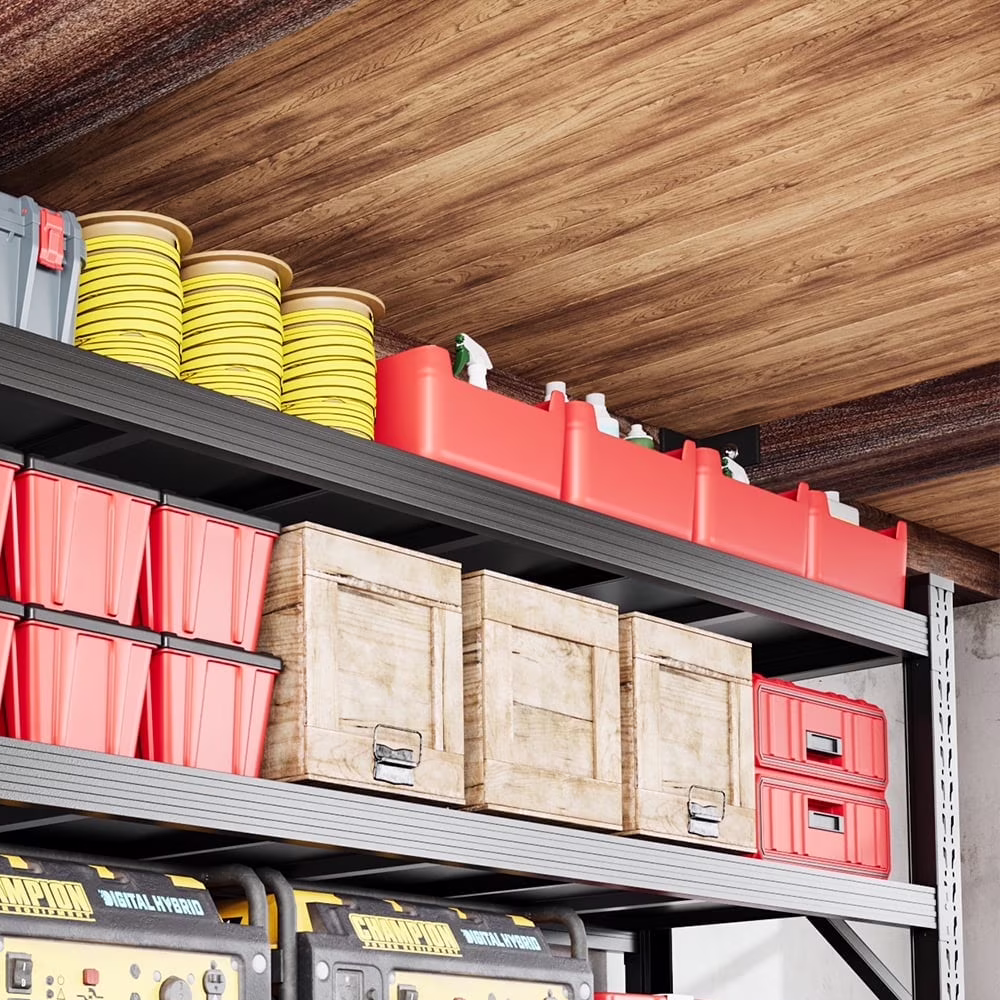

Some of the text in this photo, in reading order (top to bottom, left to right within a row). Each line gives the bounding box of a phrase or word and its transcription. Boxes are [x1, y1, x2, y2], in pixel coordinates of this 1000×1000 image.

[98, 889, 205, 916] DIGITAL HYBRID
[352, 914, 460, 950] CHAMPION
[460, 928, 542, 951] DIGITAL HYBRID
